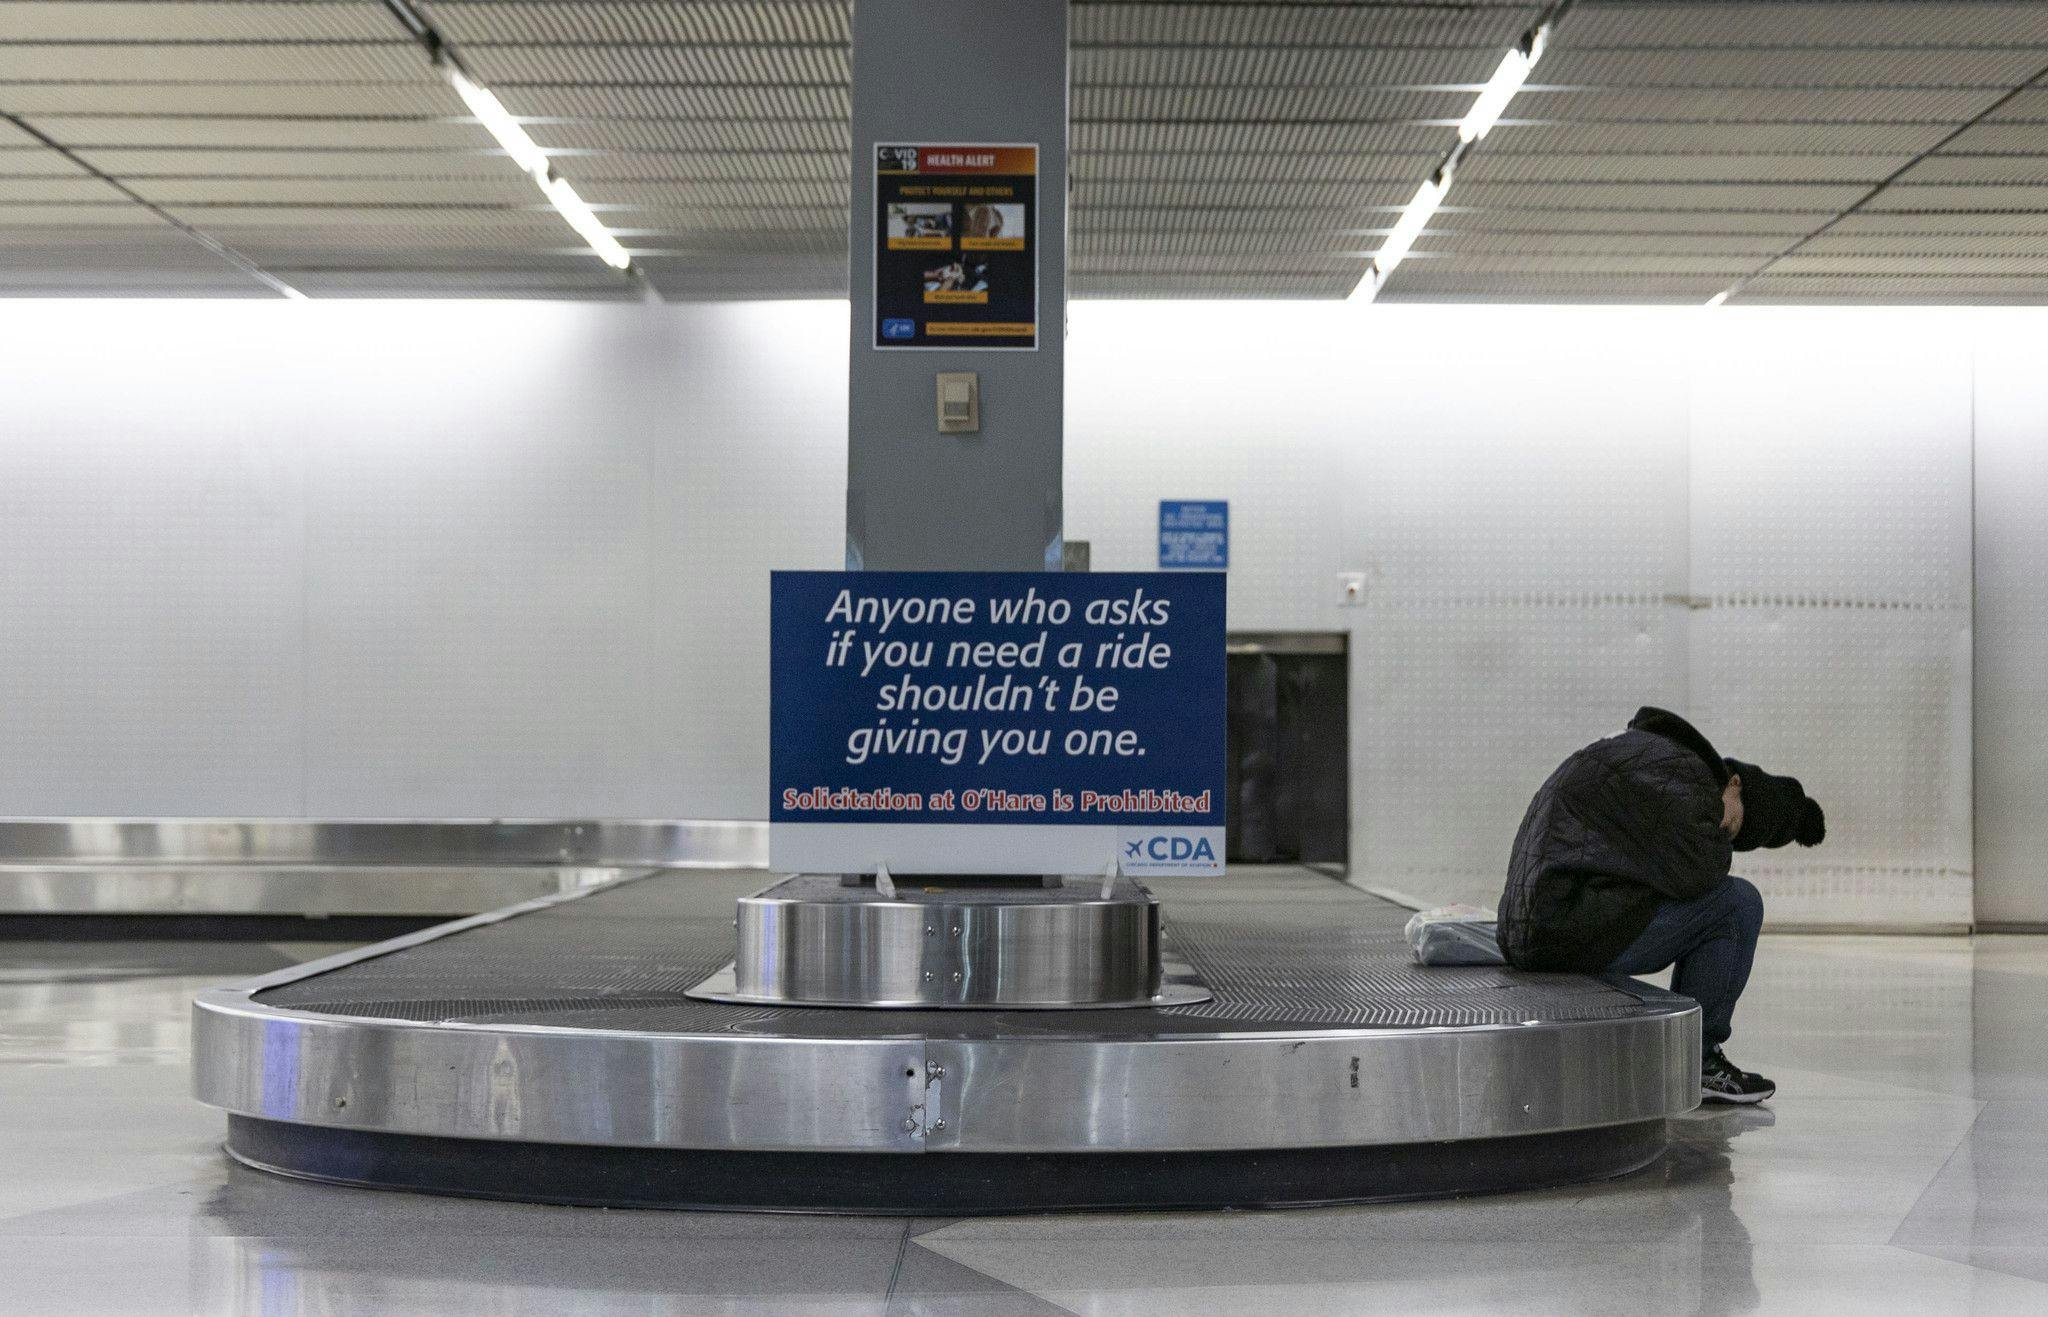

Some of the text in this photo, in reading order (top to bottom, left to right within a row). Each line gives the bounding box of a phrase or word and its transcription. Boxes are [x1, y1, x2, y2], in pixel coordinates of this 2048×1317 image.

[902, 160, 917, 171] 19
[927, 154, 994, 167] HEALTH ALERT
[825, 587, 1170, 634] Anyone who asks
[826, 630, 1171, 676] if you need a ride
[876, 673, 1119, 712] shouldn't be
[845, 718, 1146, 765] giving you one.
[783, 787, 1211, 813] Solicitation at O'Hare is Prohibited
[1147, 836, 1215, 861] CDA
